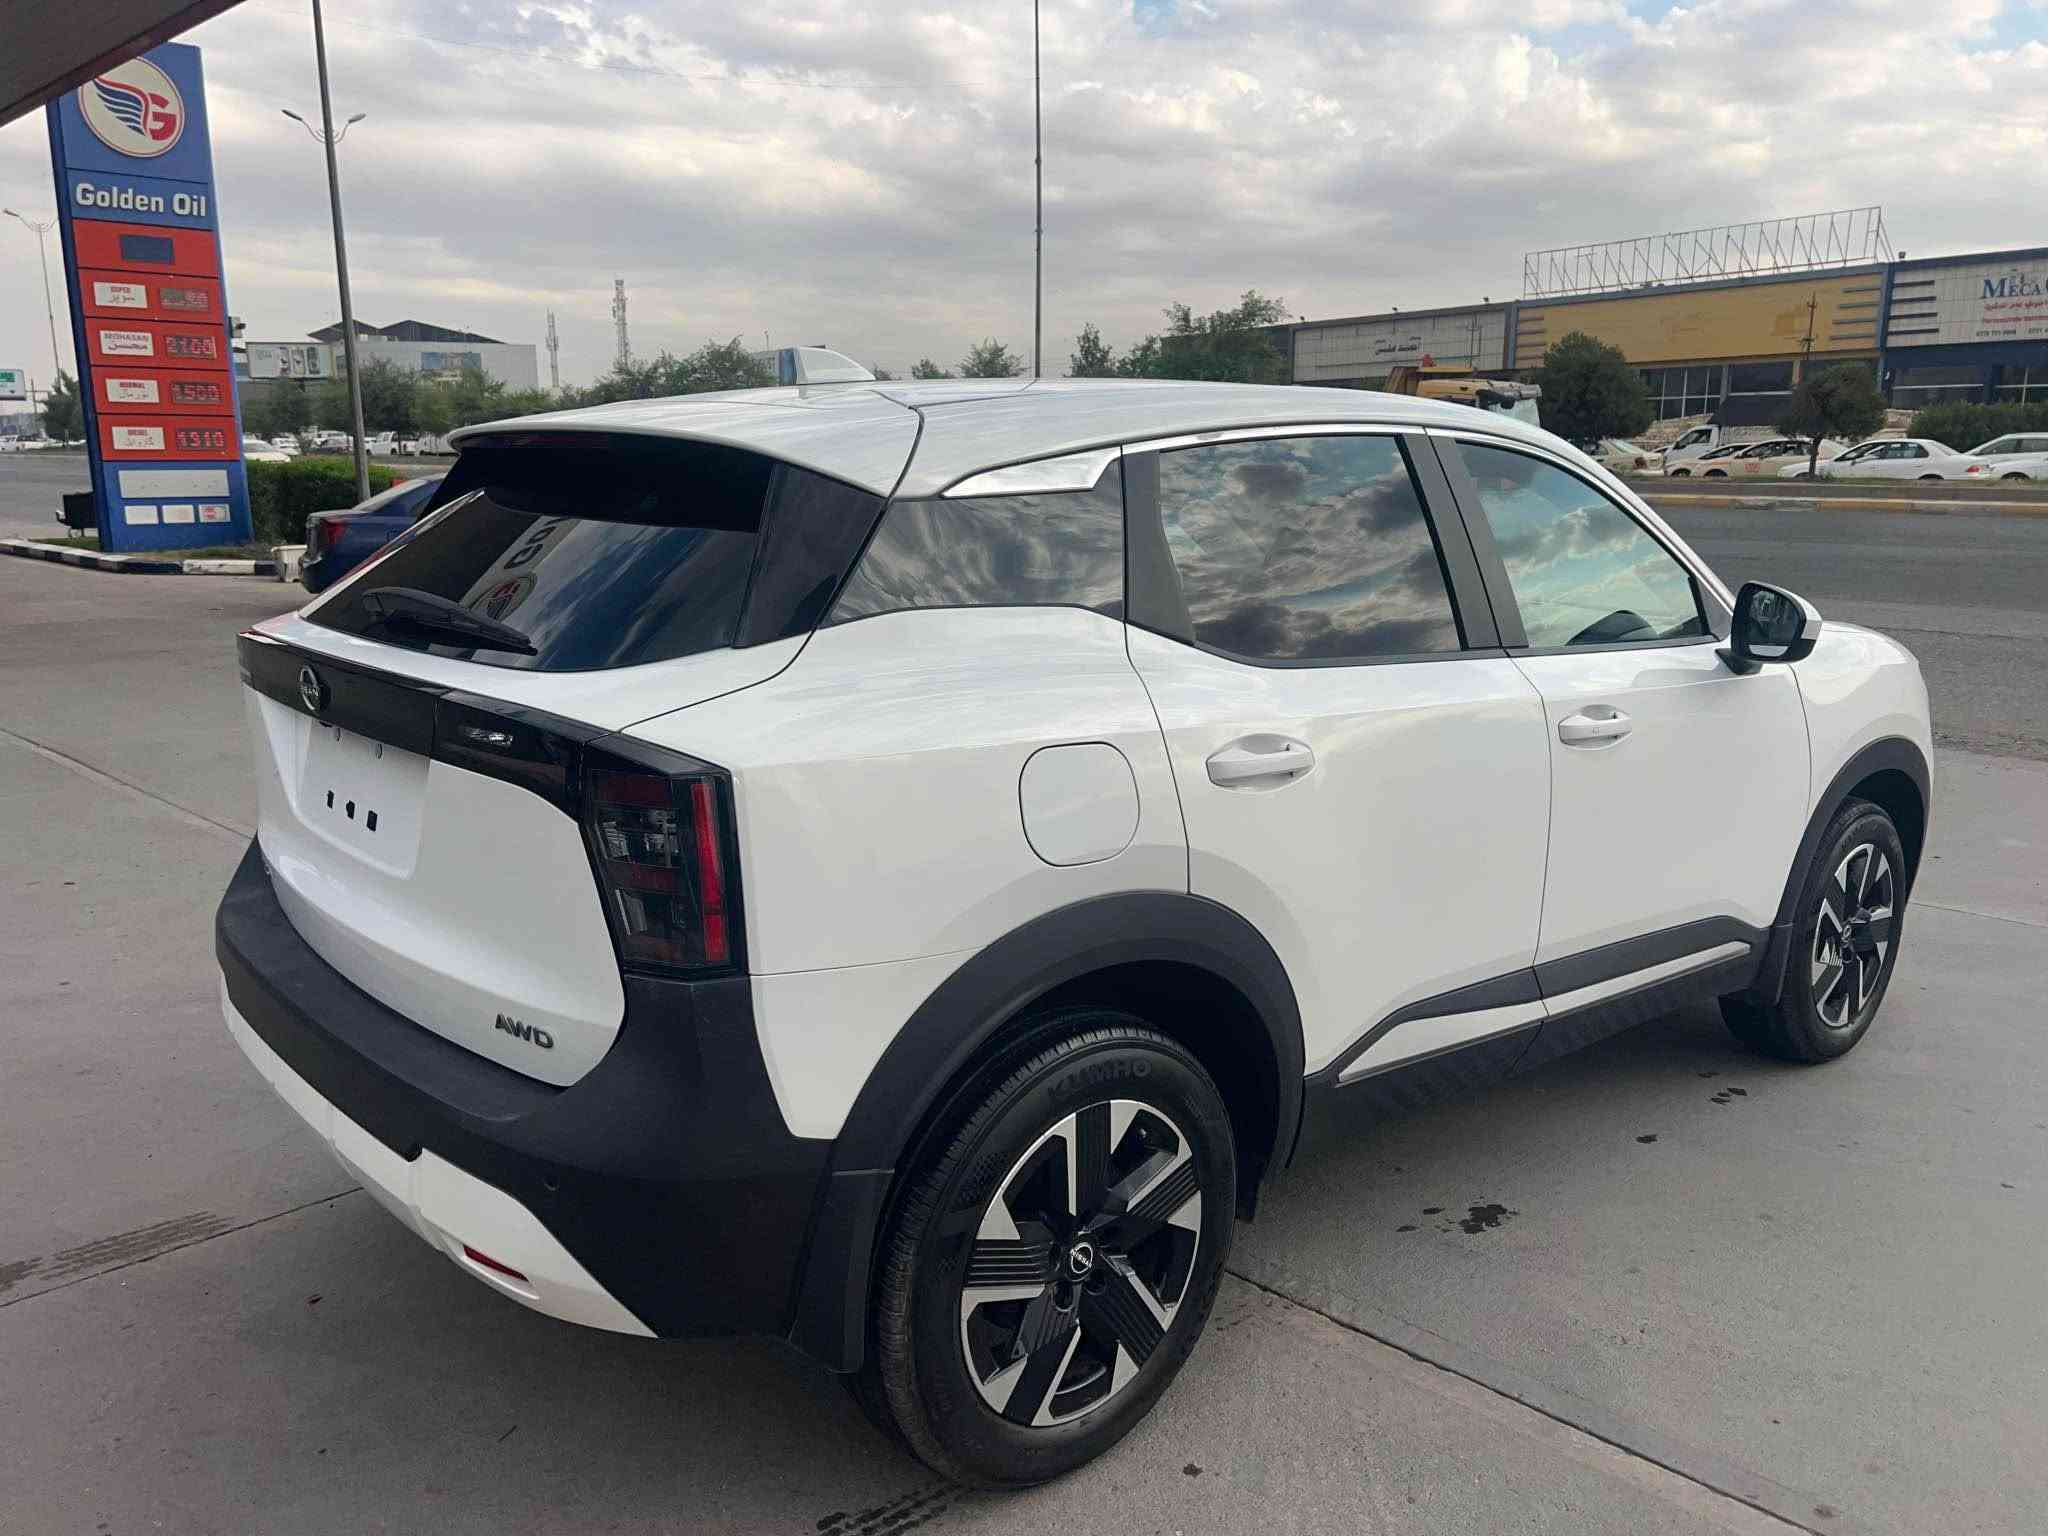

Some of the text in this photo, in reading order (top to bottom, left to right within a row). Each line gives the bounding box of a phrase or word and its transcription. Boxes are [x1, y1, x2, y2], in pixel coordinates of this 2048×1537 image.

[75, 182, 206, 217] Golden Oil
[495, 1013, 554, 1049] AWD
